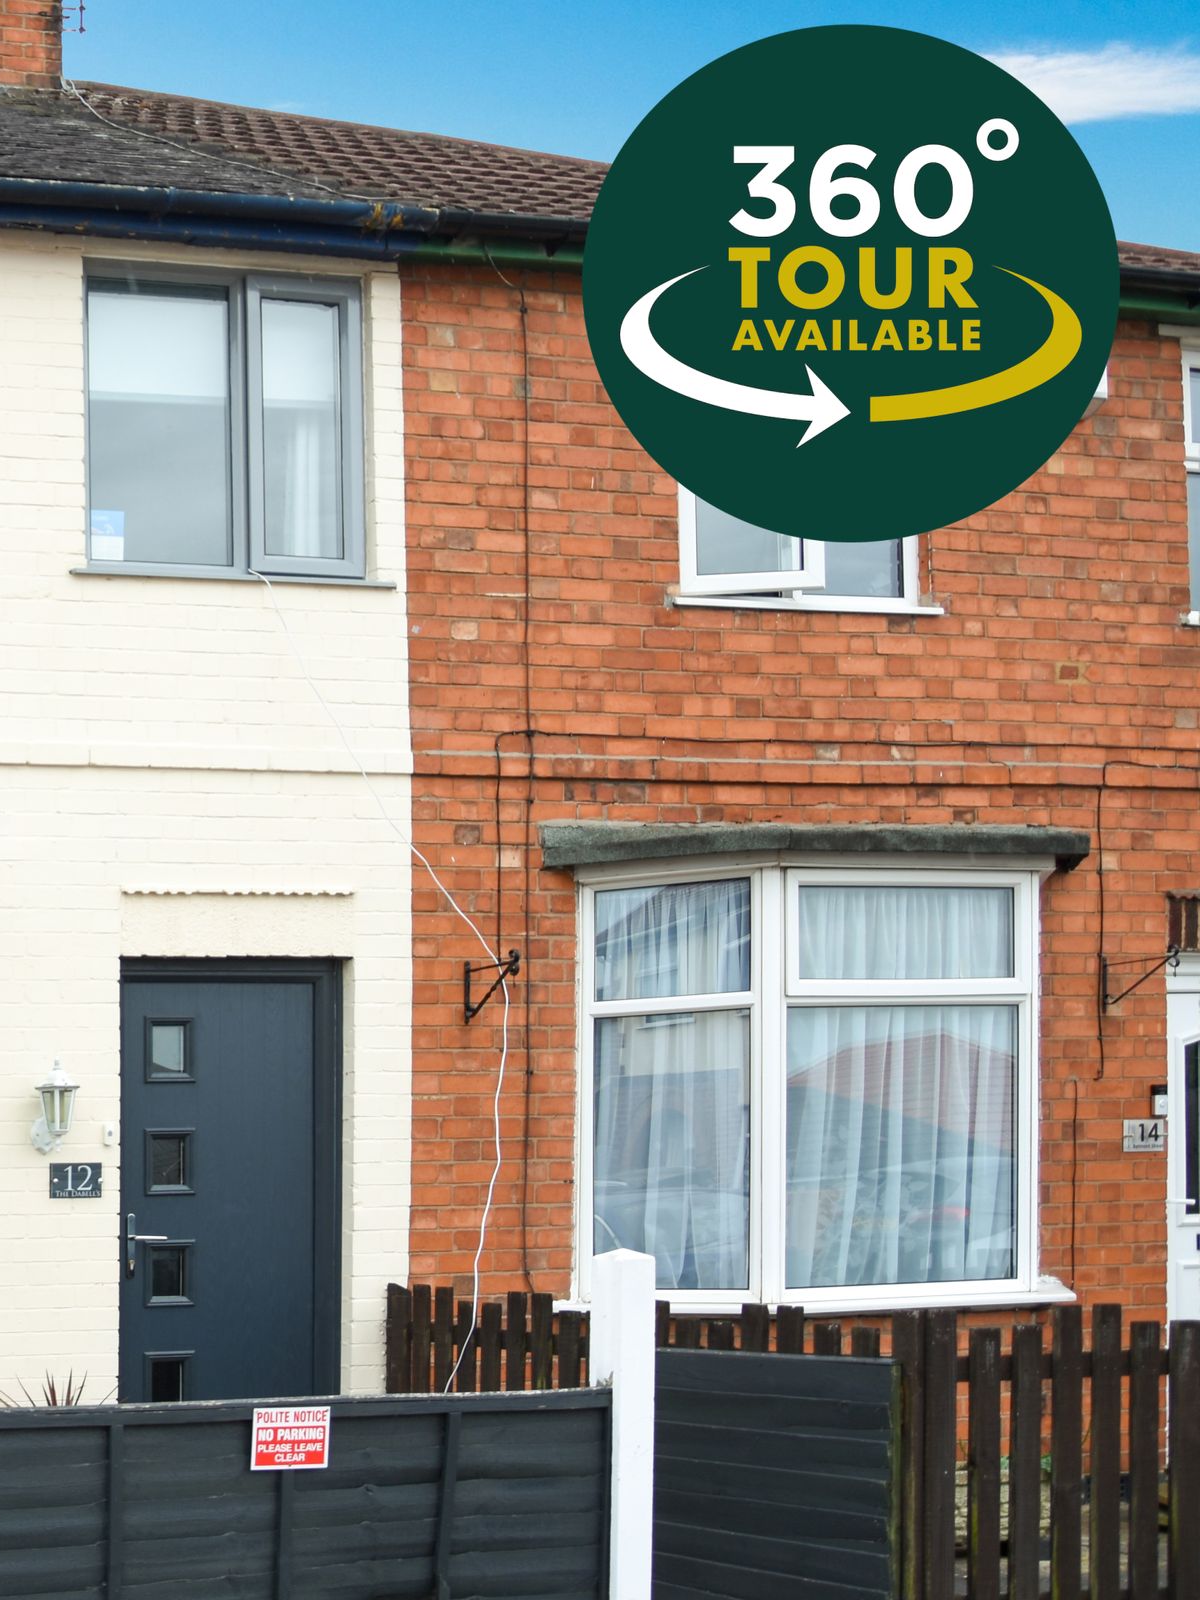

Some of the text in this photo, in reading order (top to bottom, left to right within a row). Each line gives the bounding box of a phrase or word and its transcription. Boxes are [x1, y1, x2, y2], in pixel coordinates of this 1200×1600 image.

[1138, 1122, 1159, 1142] 14
[63, 1164, 93, 1191] 12
[257, 1410, 327, 1423] POLITE NOTICE
[258, 1427, 324, 1442] NO PARKING
[257, 1442, 323, 1453] PLEASE LEAVE
[274, 1452, 306, 1463] CLEAR
